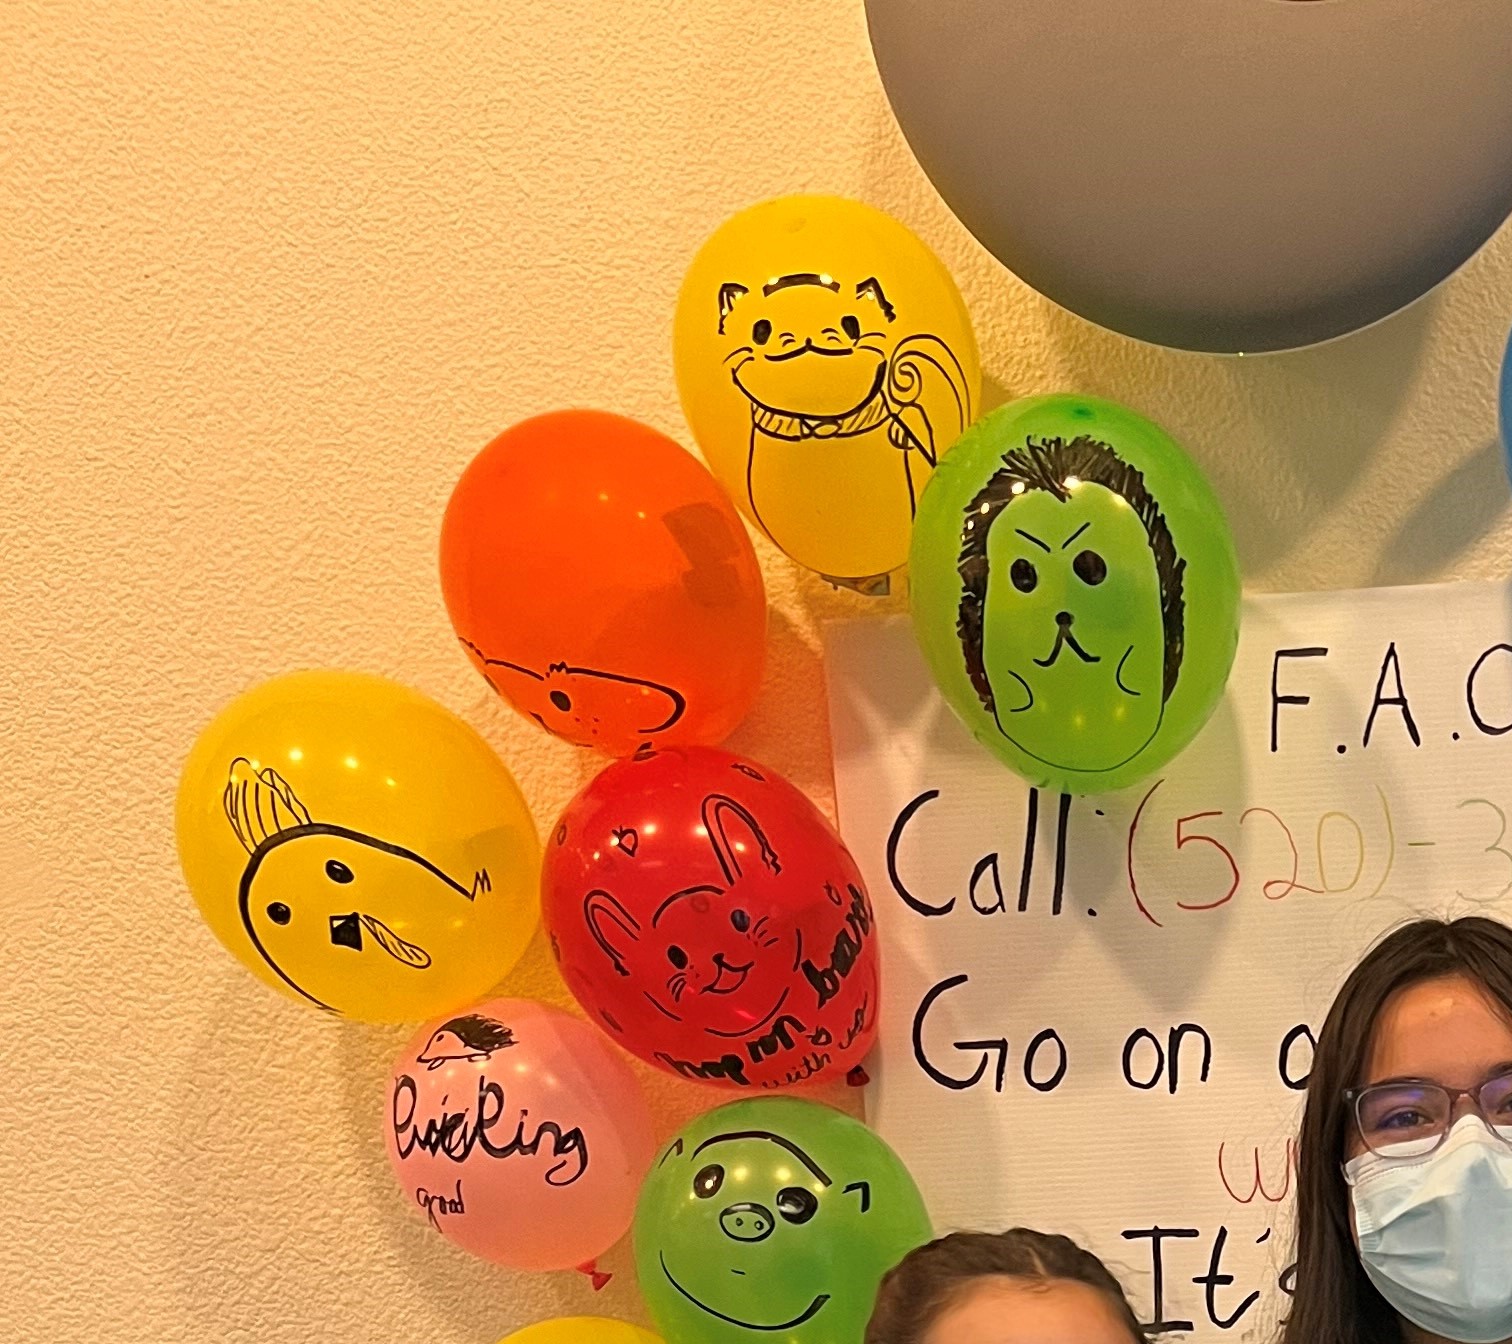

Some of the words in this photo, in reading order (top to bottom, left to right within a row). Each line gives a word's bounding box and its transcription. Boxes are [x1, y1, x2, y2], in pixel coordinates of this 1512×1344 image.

[886, 787, 1106, 917] Call:
[912, 973, 1068, 1092] Go
[1122, 1023, 1212, 1094] on
